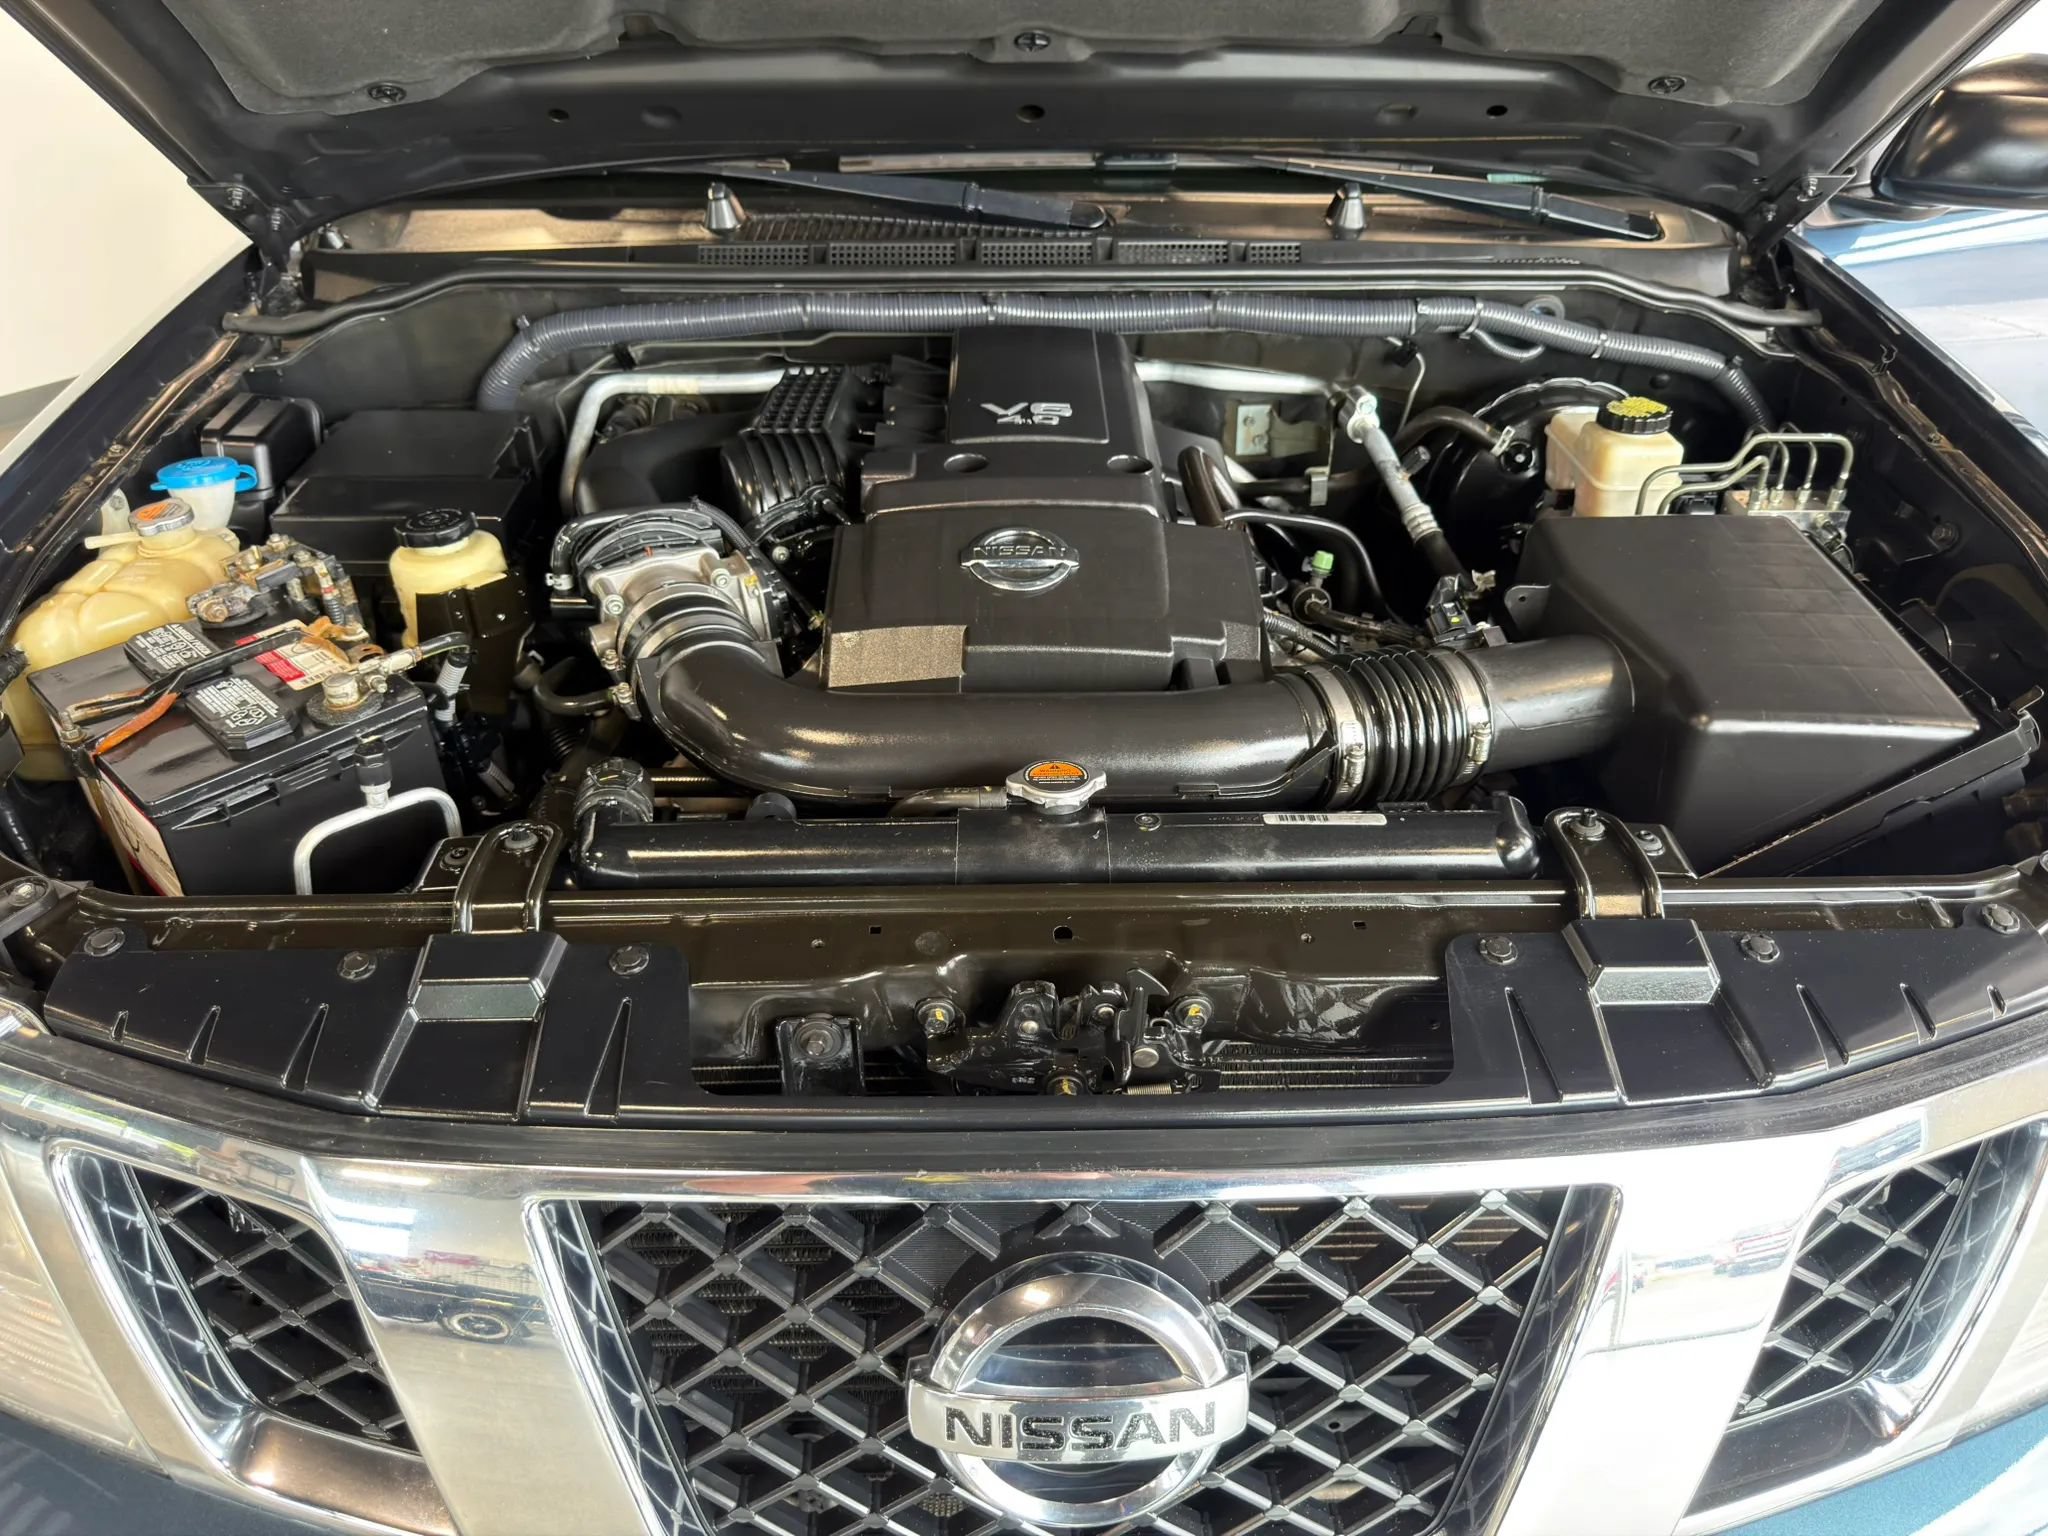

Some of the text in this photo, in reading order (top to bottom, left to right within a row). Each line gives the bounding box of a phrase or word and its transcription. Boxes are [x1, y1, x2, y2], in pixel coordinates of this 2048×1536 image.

[980, 402, 1073, 417] V6
[972, 546, 1066, 557] NISSAN
[945, 1402, 1216, 1451] NISSAN
